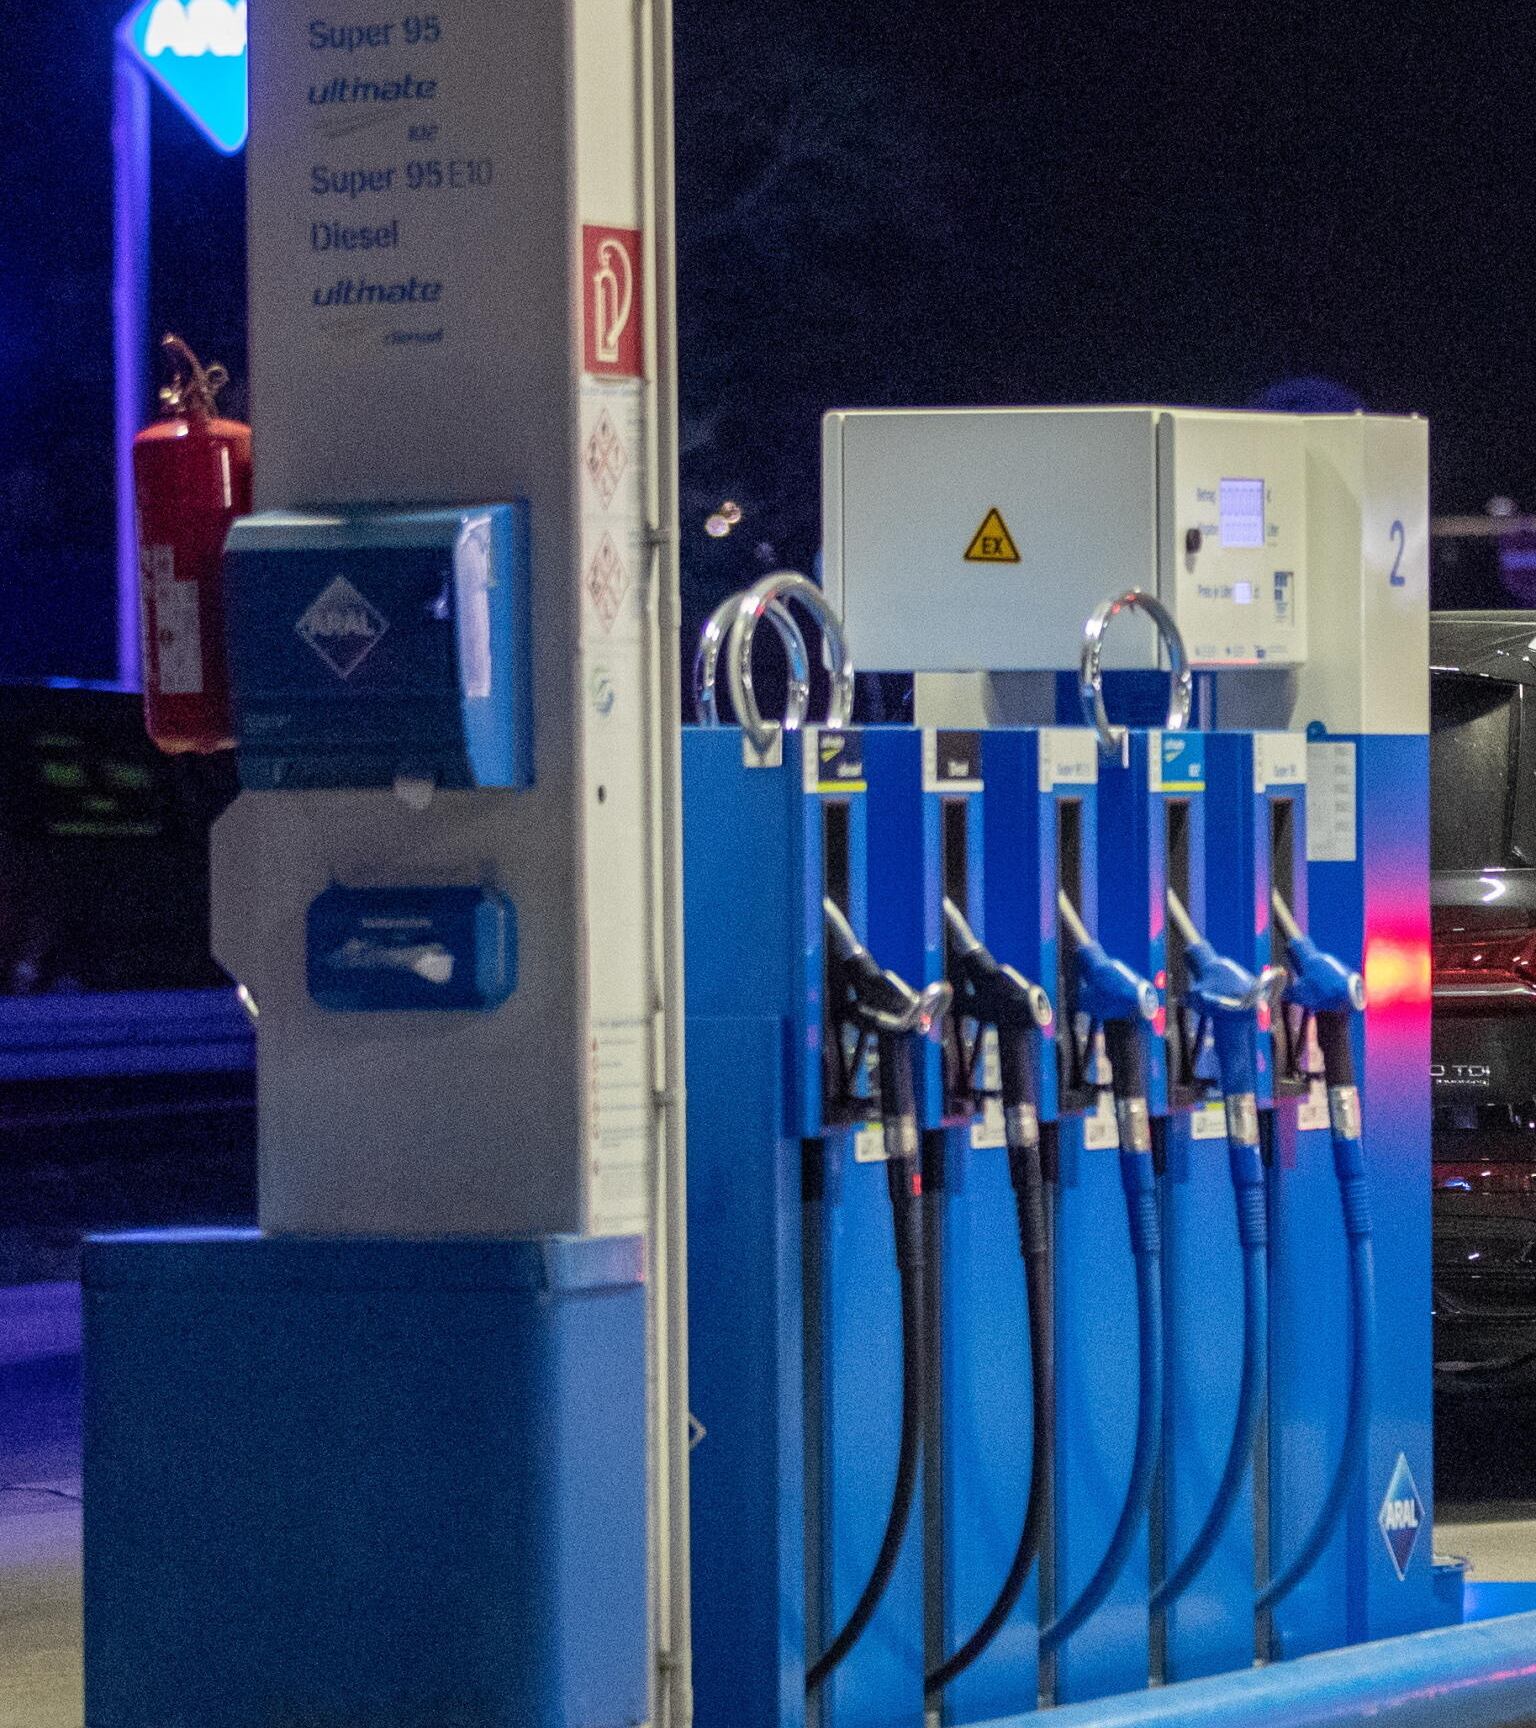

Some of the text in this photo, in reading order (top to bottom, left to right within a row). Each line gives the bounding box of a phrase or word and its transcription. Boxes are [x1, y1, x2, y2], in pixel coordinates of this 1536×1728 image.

[308, 16, 441, 52] Super 95
[307, 74, 438, 105] ultimate
[310, 160, 494, 199] Super 95 E10
[311, 220, 399, 251] Diesel
[312, 276, 443, 307] ultimate
[982, 536, 1004, 555] EX
[1388, 518, 1407, 588] 2
[1452, 1064, 1491, 1077] TDI
[1384, 1499, 1419, 1531] ARAL
